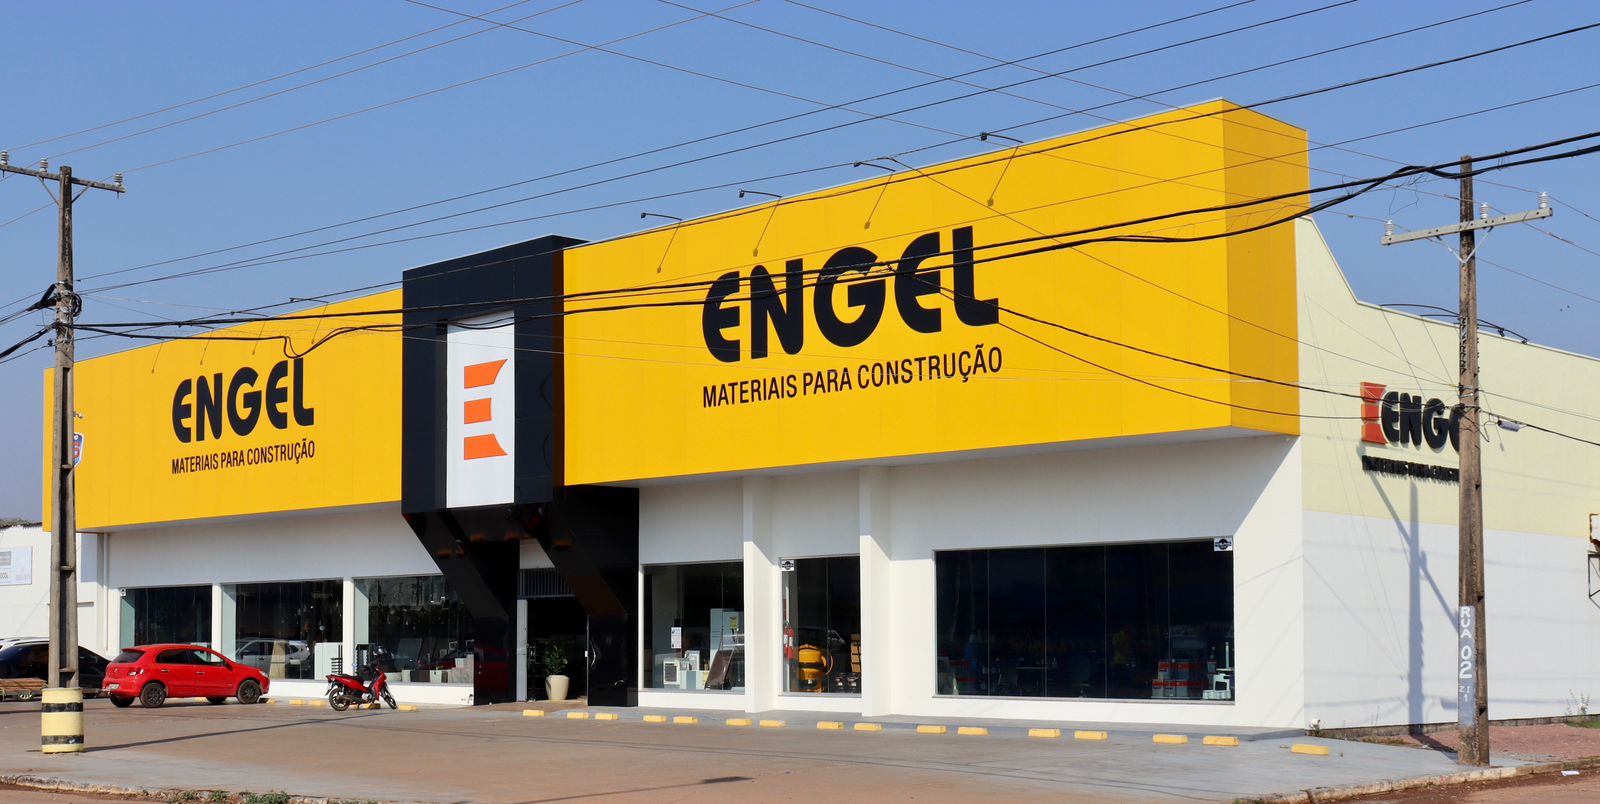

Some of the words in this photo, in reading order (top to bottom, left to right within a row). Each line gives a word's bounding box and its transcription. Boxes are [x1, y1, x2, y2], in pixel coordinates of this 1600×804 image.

[702, 226, 999, 363] ENGEL
[172, 357, 315, 443] ENGEL
[703, 375, 798, 408] MATERIAIS
[802, 366, 853, 397] PARA
[858, 343, 1003, 390] CONSTRUÇÃO
[171, 453, 220, 475] MATERIAIS
[220, 449, 246, 469] PARA
[246, 438, 316, 465] CONSTRUÇÃO
[1460, 606, 1472, 639] RUA
[1459, 645, 1473, 679] 02
